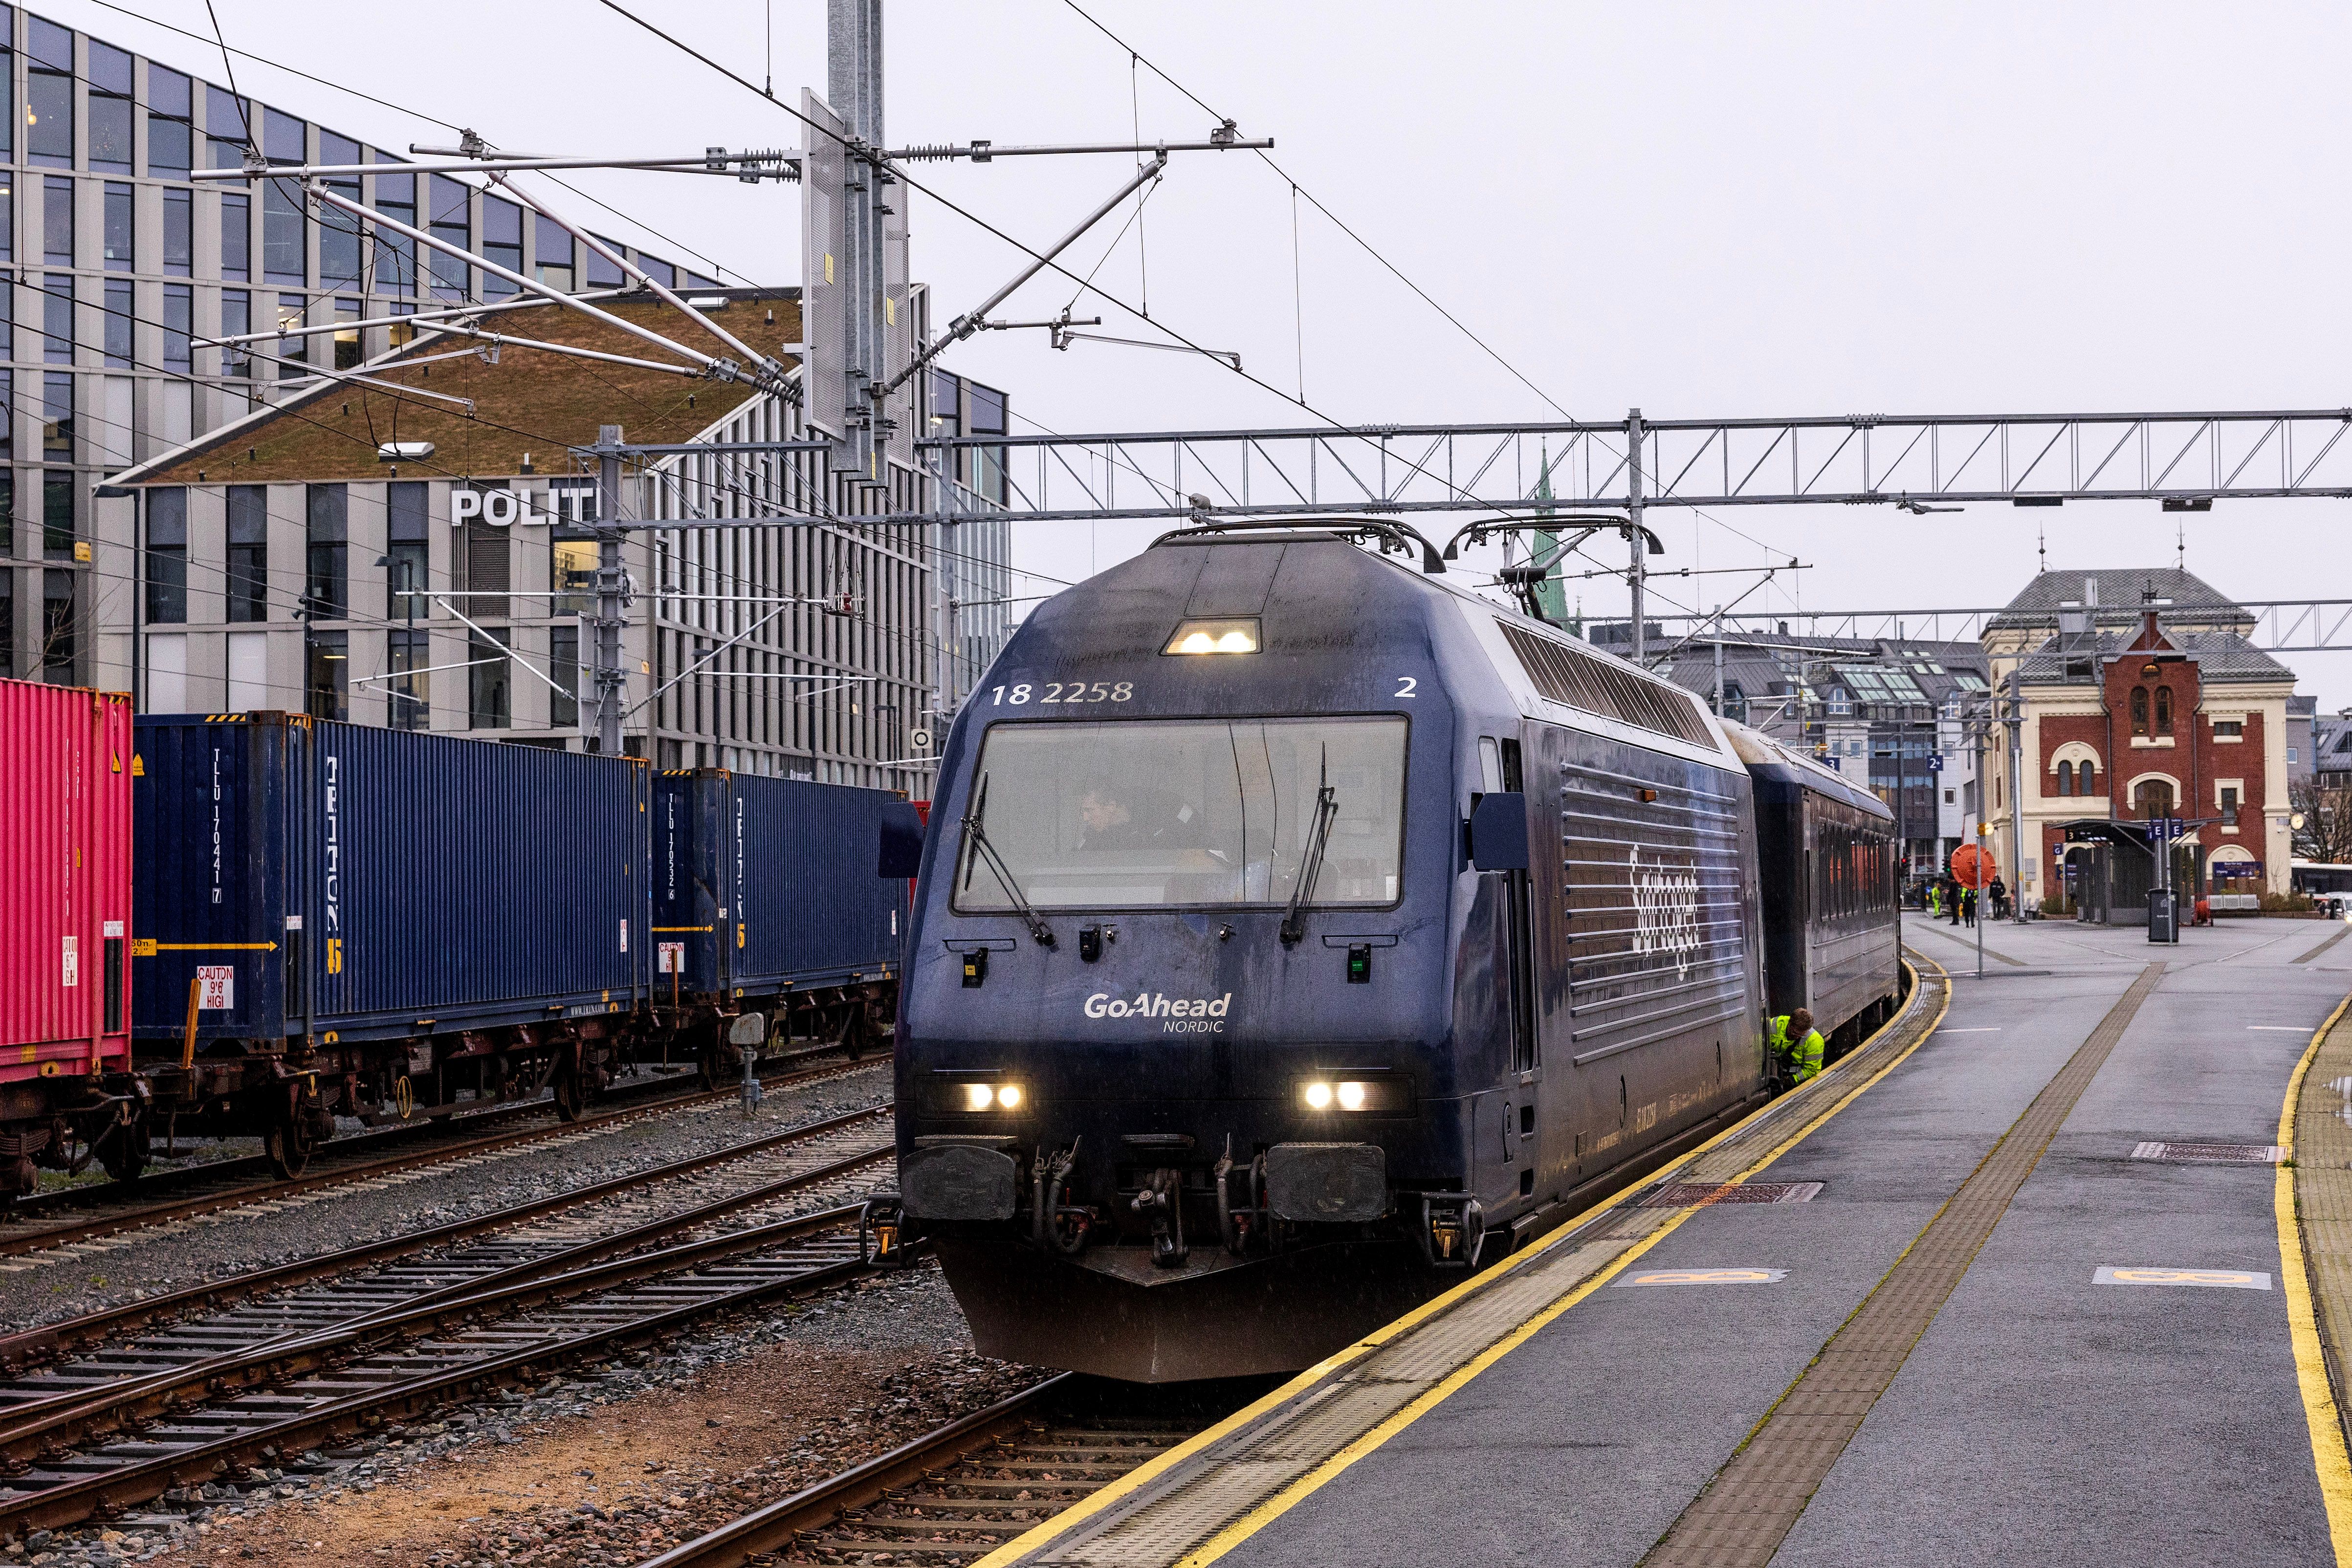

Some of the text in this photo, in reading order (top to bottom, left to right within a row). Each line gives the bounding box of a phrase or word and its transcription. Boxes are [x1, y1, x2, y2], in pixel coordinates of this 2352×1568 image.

[992, 681, 1134, 706] 18 2258
[1394, 677, 1417, 698] 2
[1828, 760, 1835, 769] 3
[1929, 758, 1937, 769] 2
[2155, 826, 2161, 835] E
[2174, 826, 2179, 835] E
[214, 888, 221, 903] 7
[669, 890, 674, 899] 6
[660, 944, 683, 952] CAUTON
[198, 967, 232, 980] CAUTON
[1084, 993, 1232, 1018] GoAhead
[1163, 1020, 1224, 1033] NORDIC
